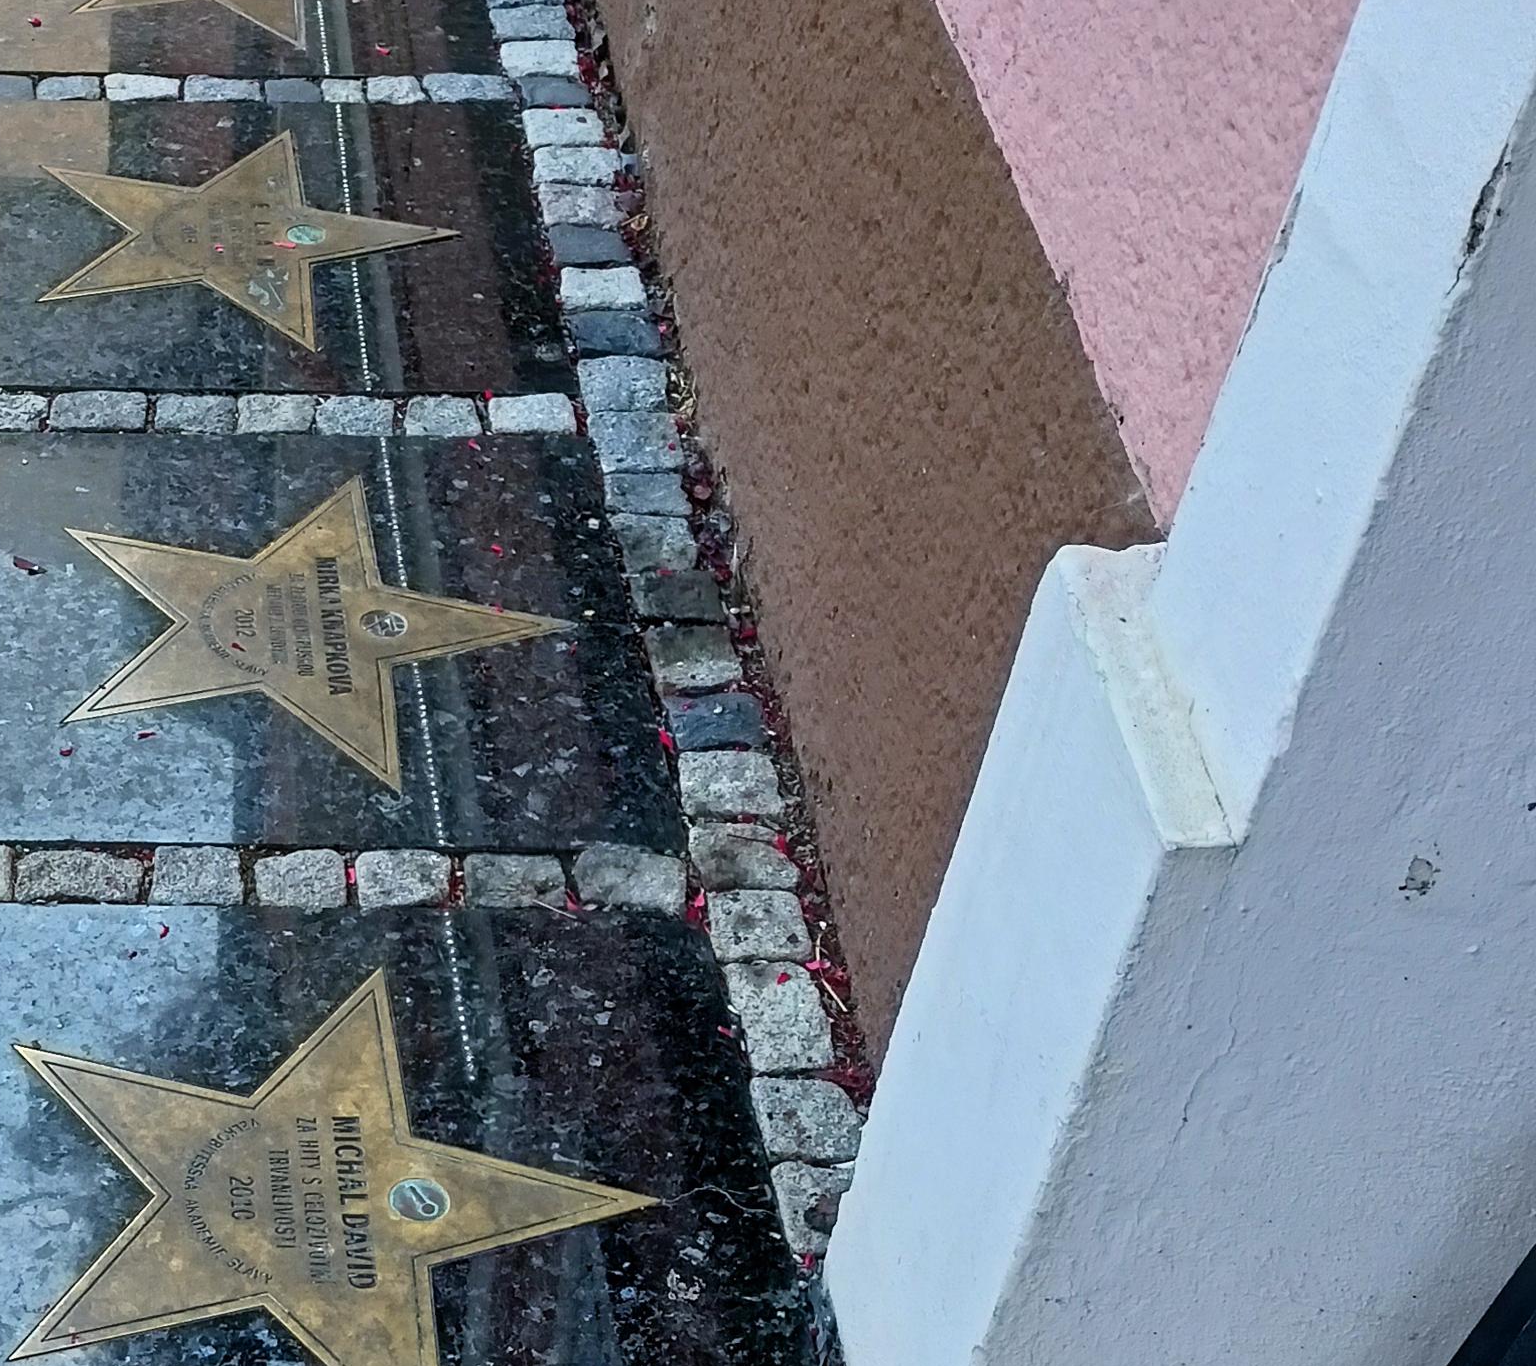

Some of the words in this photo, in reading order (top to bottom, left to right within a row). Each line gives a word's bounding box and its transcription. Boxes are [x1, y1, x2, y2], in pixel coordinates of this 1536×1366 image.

[316, 557, 341, 604] MIRKA
[235, 609, 257, 638] 2012
[296, 1117, 317, 1133] ZA
[298, 1140, 321, 1170] HITY
[331, 1116, 369, 1206] MICHAL
[229, 1175, 256, 1221] 2010
[302, 1176, 323, 1186] S
[341, 1213, 378, 1290] DAVID
